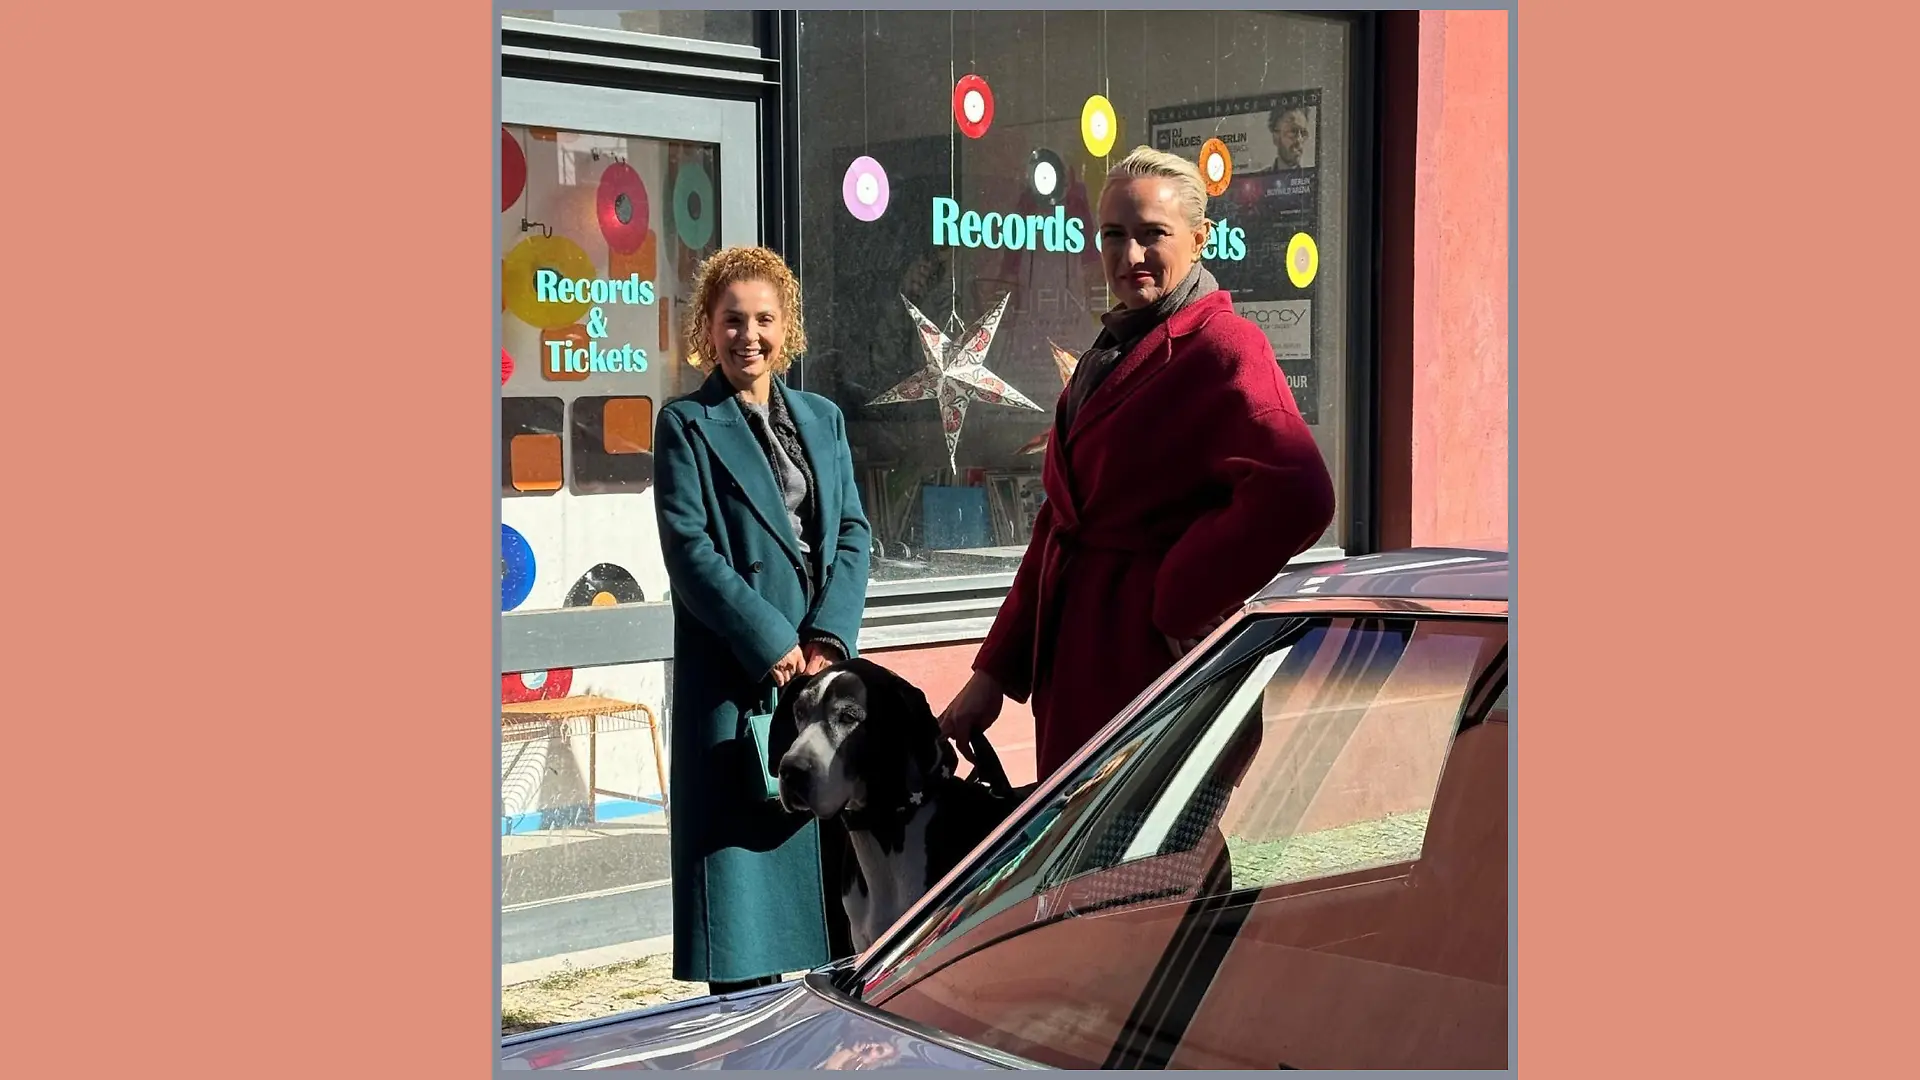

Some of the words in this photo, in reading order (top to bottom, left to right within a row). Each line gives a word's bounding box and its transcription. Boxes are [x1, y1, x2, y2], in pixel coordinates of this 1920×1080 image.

[1171, 135, 1202, 148] NADES
[1172, 127, 1182, 137] DJ
[932, 196, 1085, 254] Records
[537, 270, 655, 305] Records
[586, 306, 608, 338] &
[545, 340, 648, 373] Tickets
[1286, 375, 1308, 388] OUR
